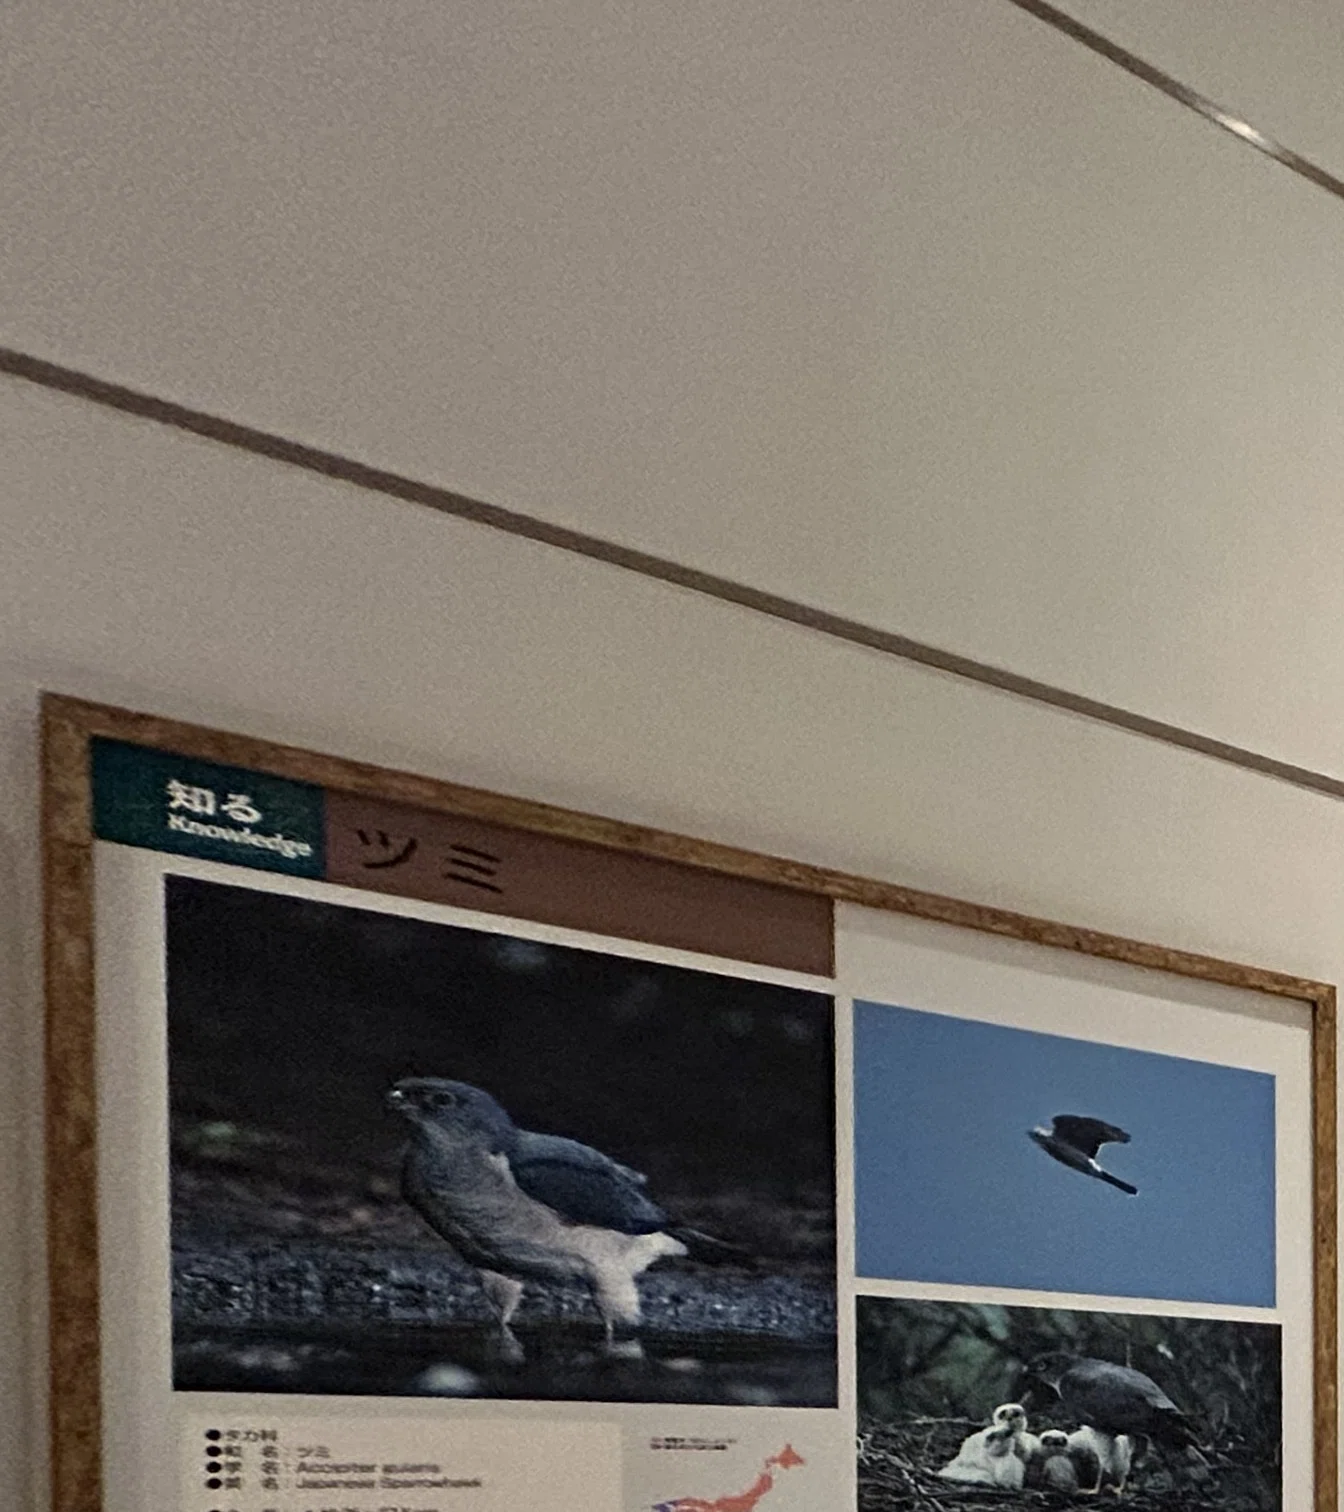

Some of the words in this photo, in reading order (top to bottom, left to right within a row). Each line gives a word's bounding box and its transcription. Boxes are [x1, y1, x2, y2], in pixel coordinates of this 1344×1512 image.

[166, 779, 262, 824] 知る
[167, 812, 313, 860] Knowledge
[357, 828, 503, 893] ツミ
